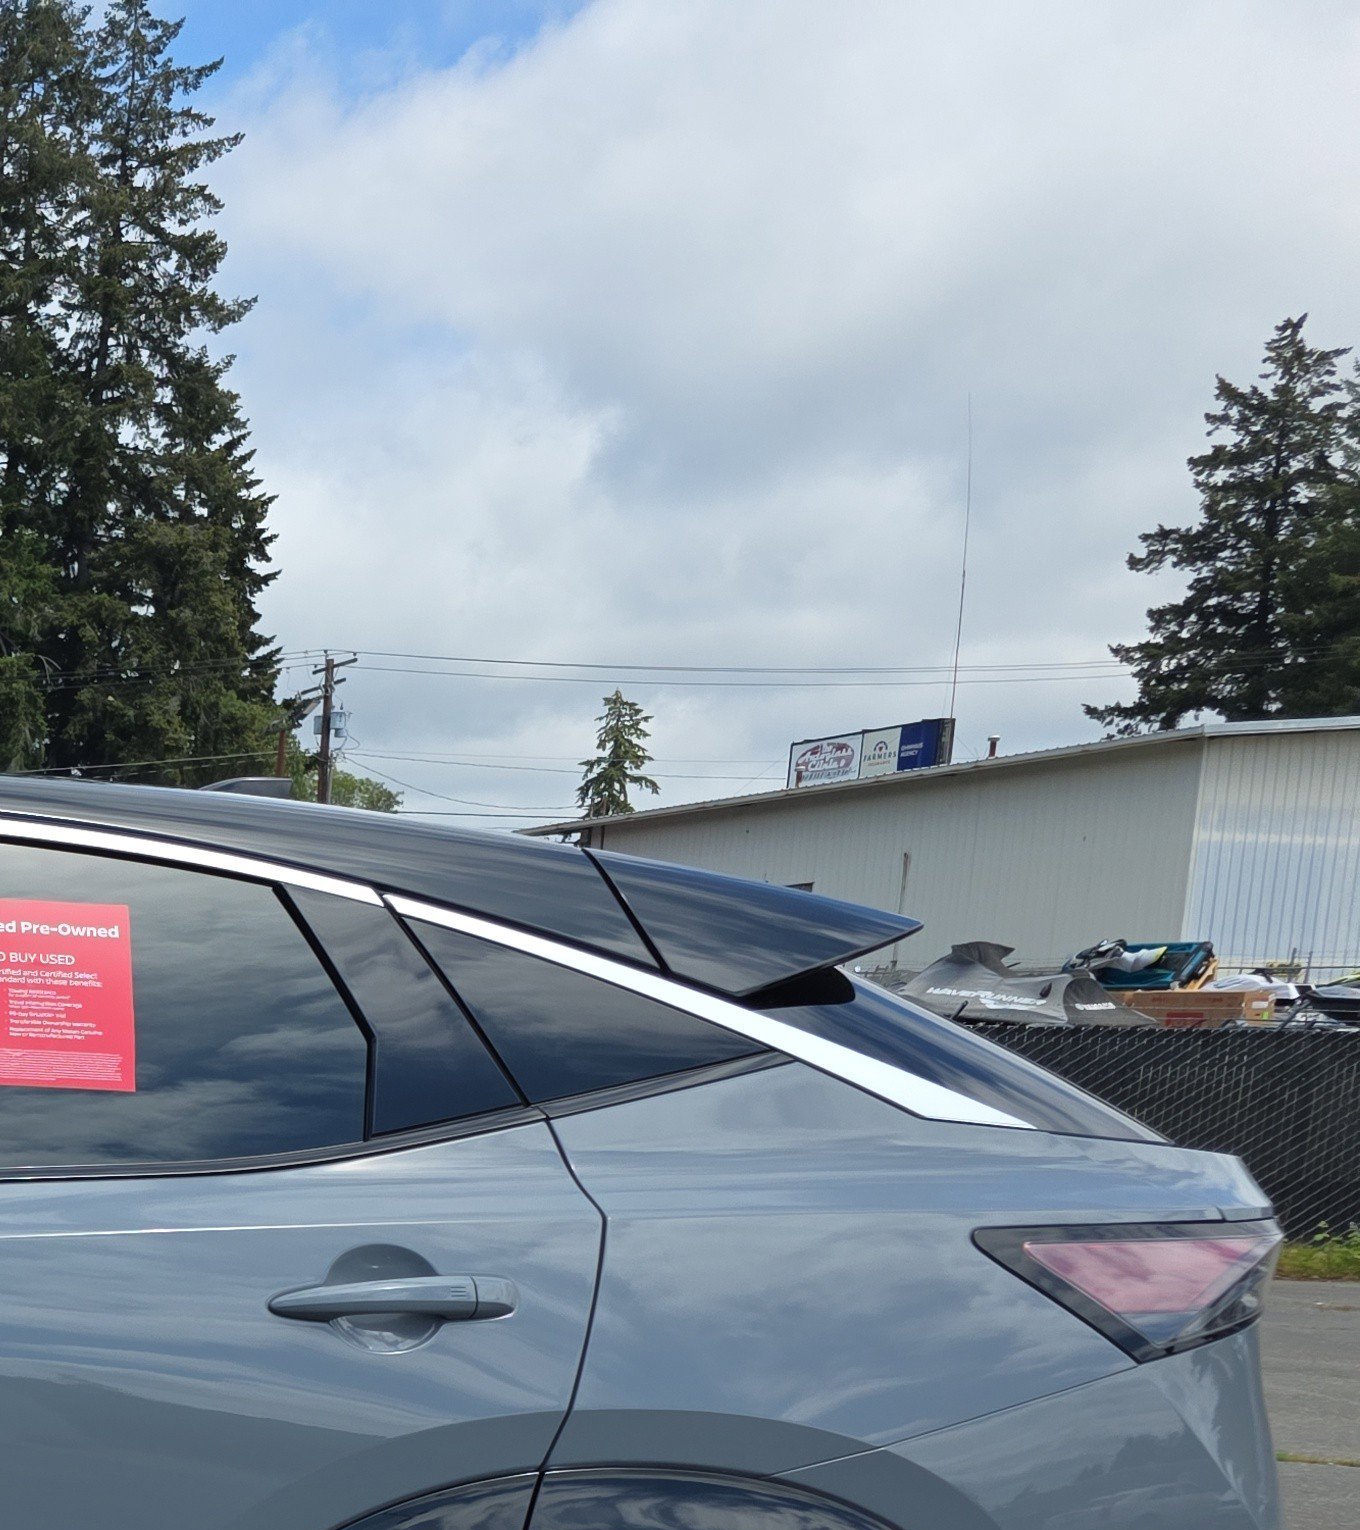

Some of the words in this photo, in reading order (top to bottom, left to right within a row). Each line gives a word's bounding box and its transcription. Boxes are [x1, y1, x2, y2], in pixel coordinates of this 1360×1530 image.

[863, 750, 897, 762] FARMERS
[21, 922, 120, 939] Pre-Owned
[9, 952, 37, 963] BUY
[39, 954, 75, 965] USED
